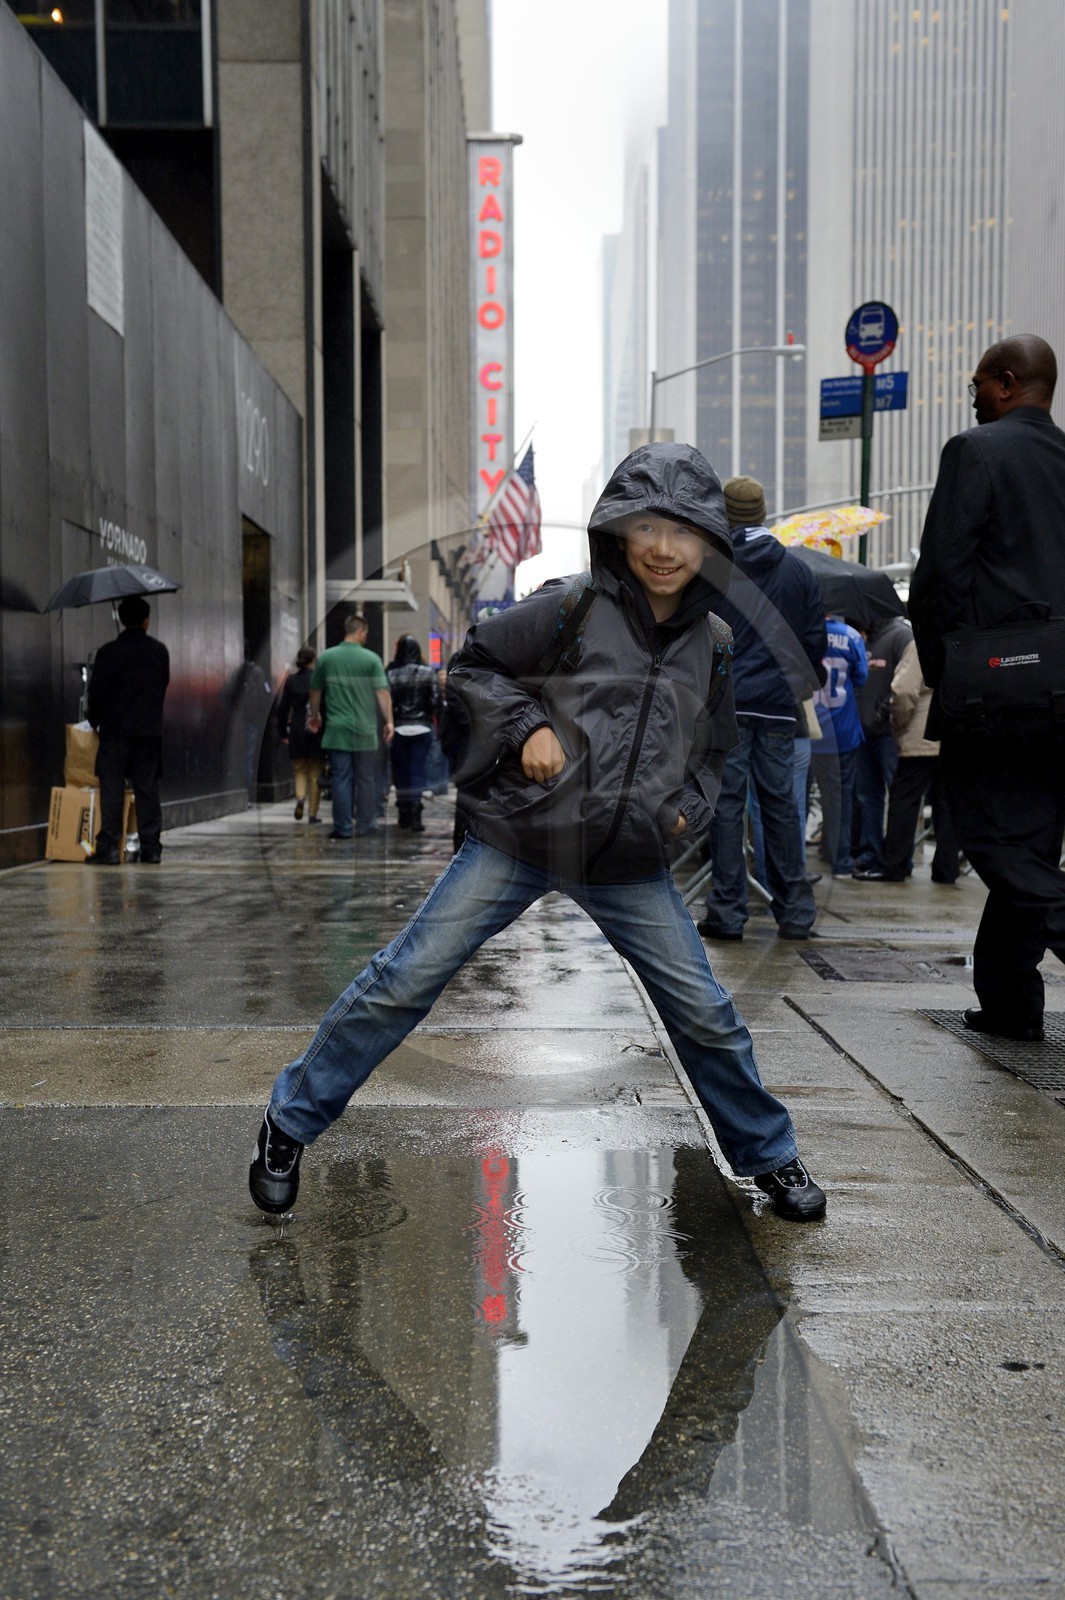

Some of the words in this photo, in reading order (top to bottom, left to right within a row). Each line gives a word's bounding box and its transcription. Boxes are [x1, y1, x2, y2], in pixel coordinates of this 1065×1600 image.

[478, 156, 506, 331] RADIO
[876, 375, 895, 390] M5
[875, 394, 893, 409] M7
[479, 362, 505, 496] CITY
[99, 517, 148, 565] VORNADO
[827, 633, 850, 651] PAUL
